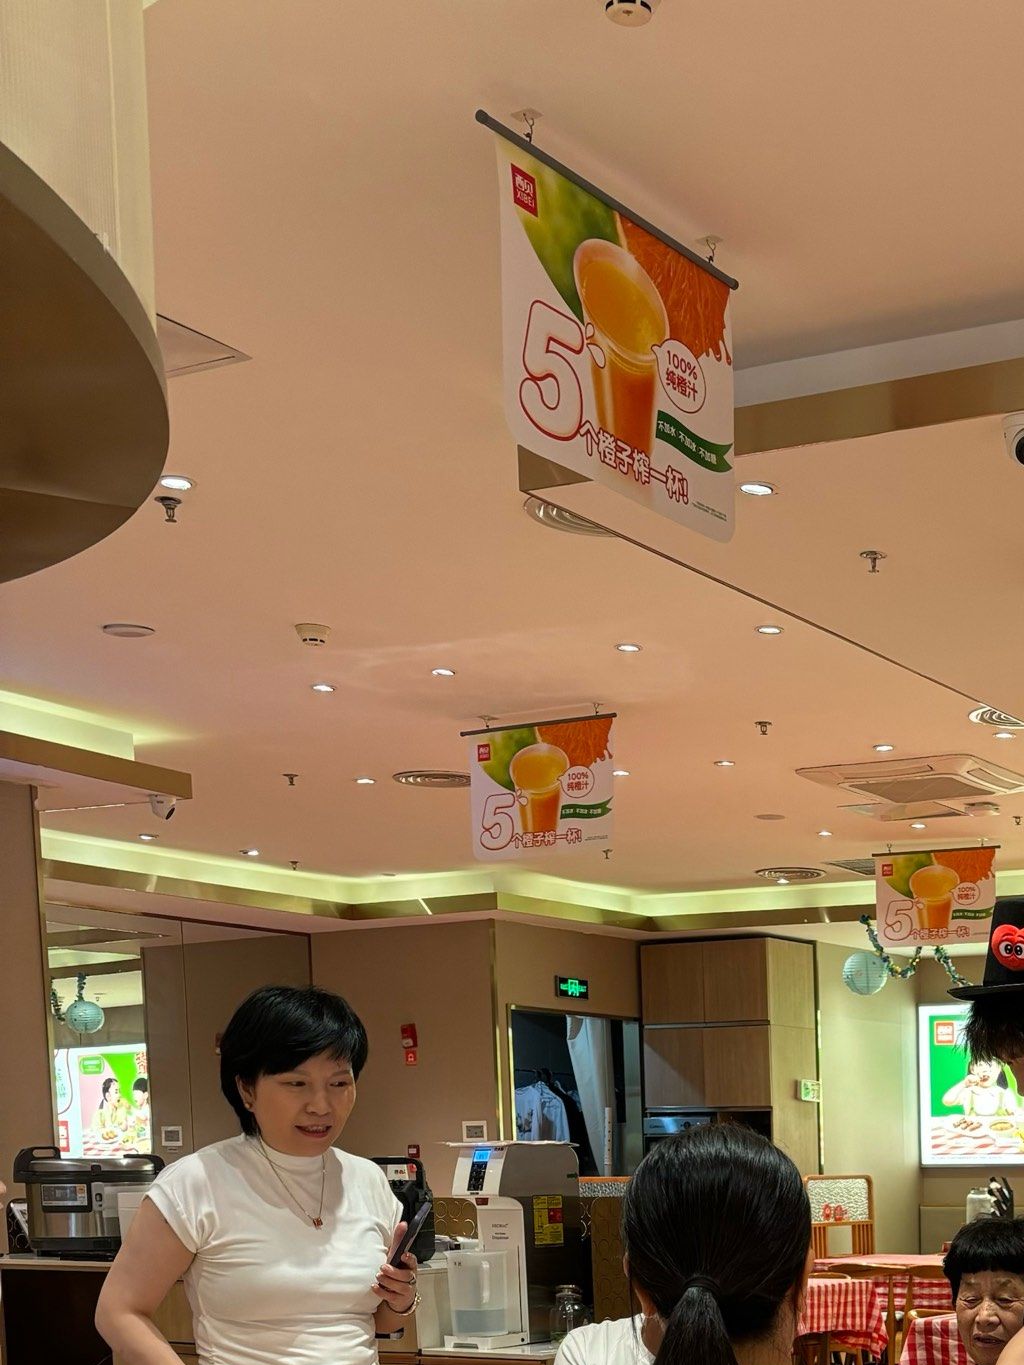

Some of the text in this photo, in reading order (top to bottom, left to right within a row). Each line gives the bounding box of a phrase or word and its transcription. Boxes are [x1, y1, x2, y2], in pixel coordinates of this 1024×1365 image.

[666, 350, 698, 381] 100%
[665, 368, 698, 402] 纯橙汁
[567, 771, 589, 781] 100%
